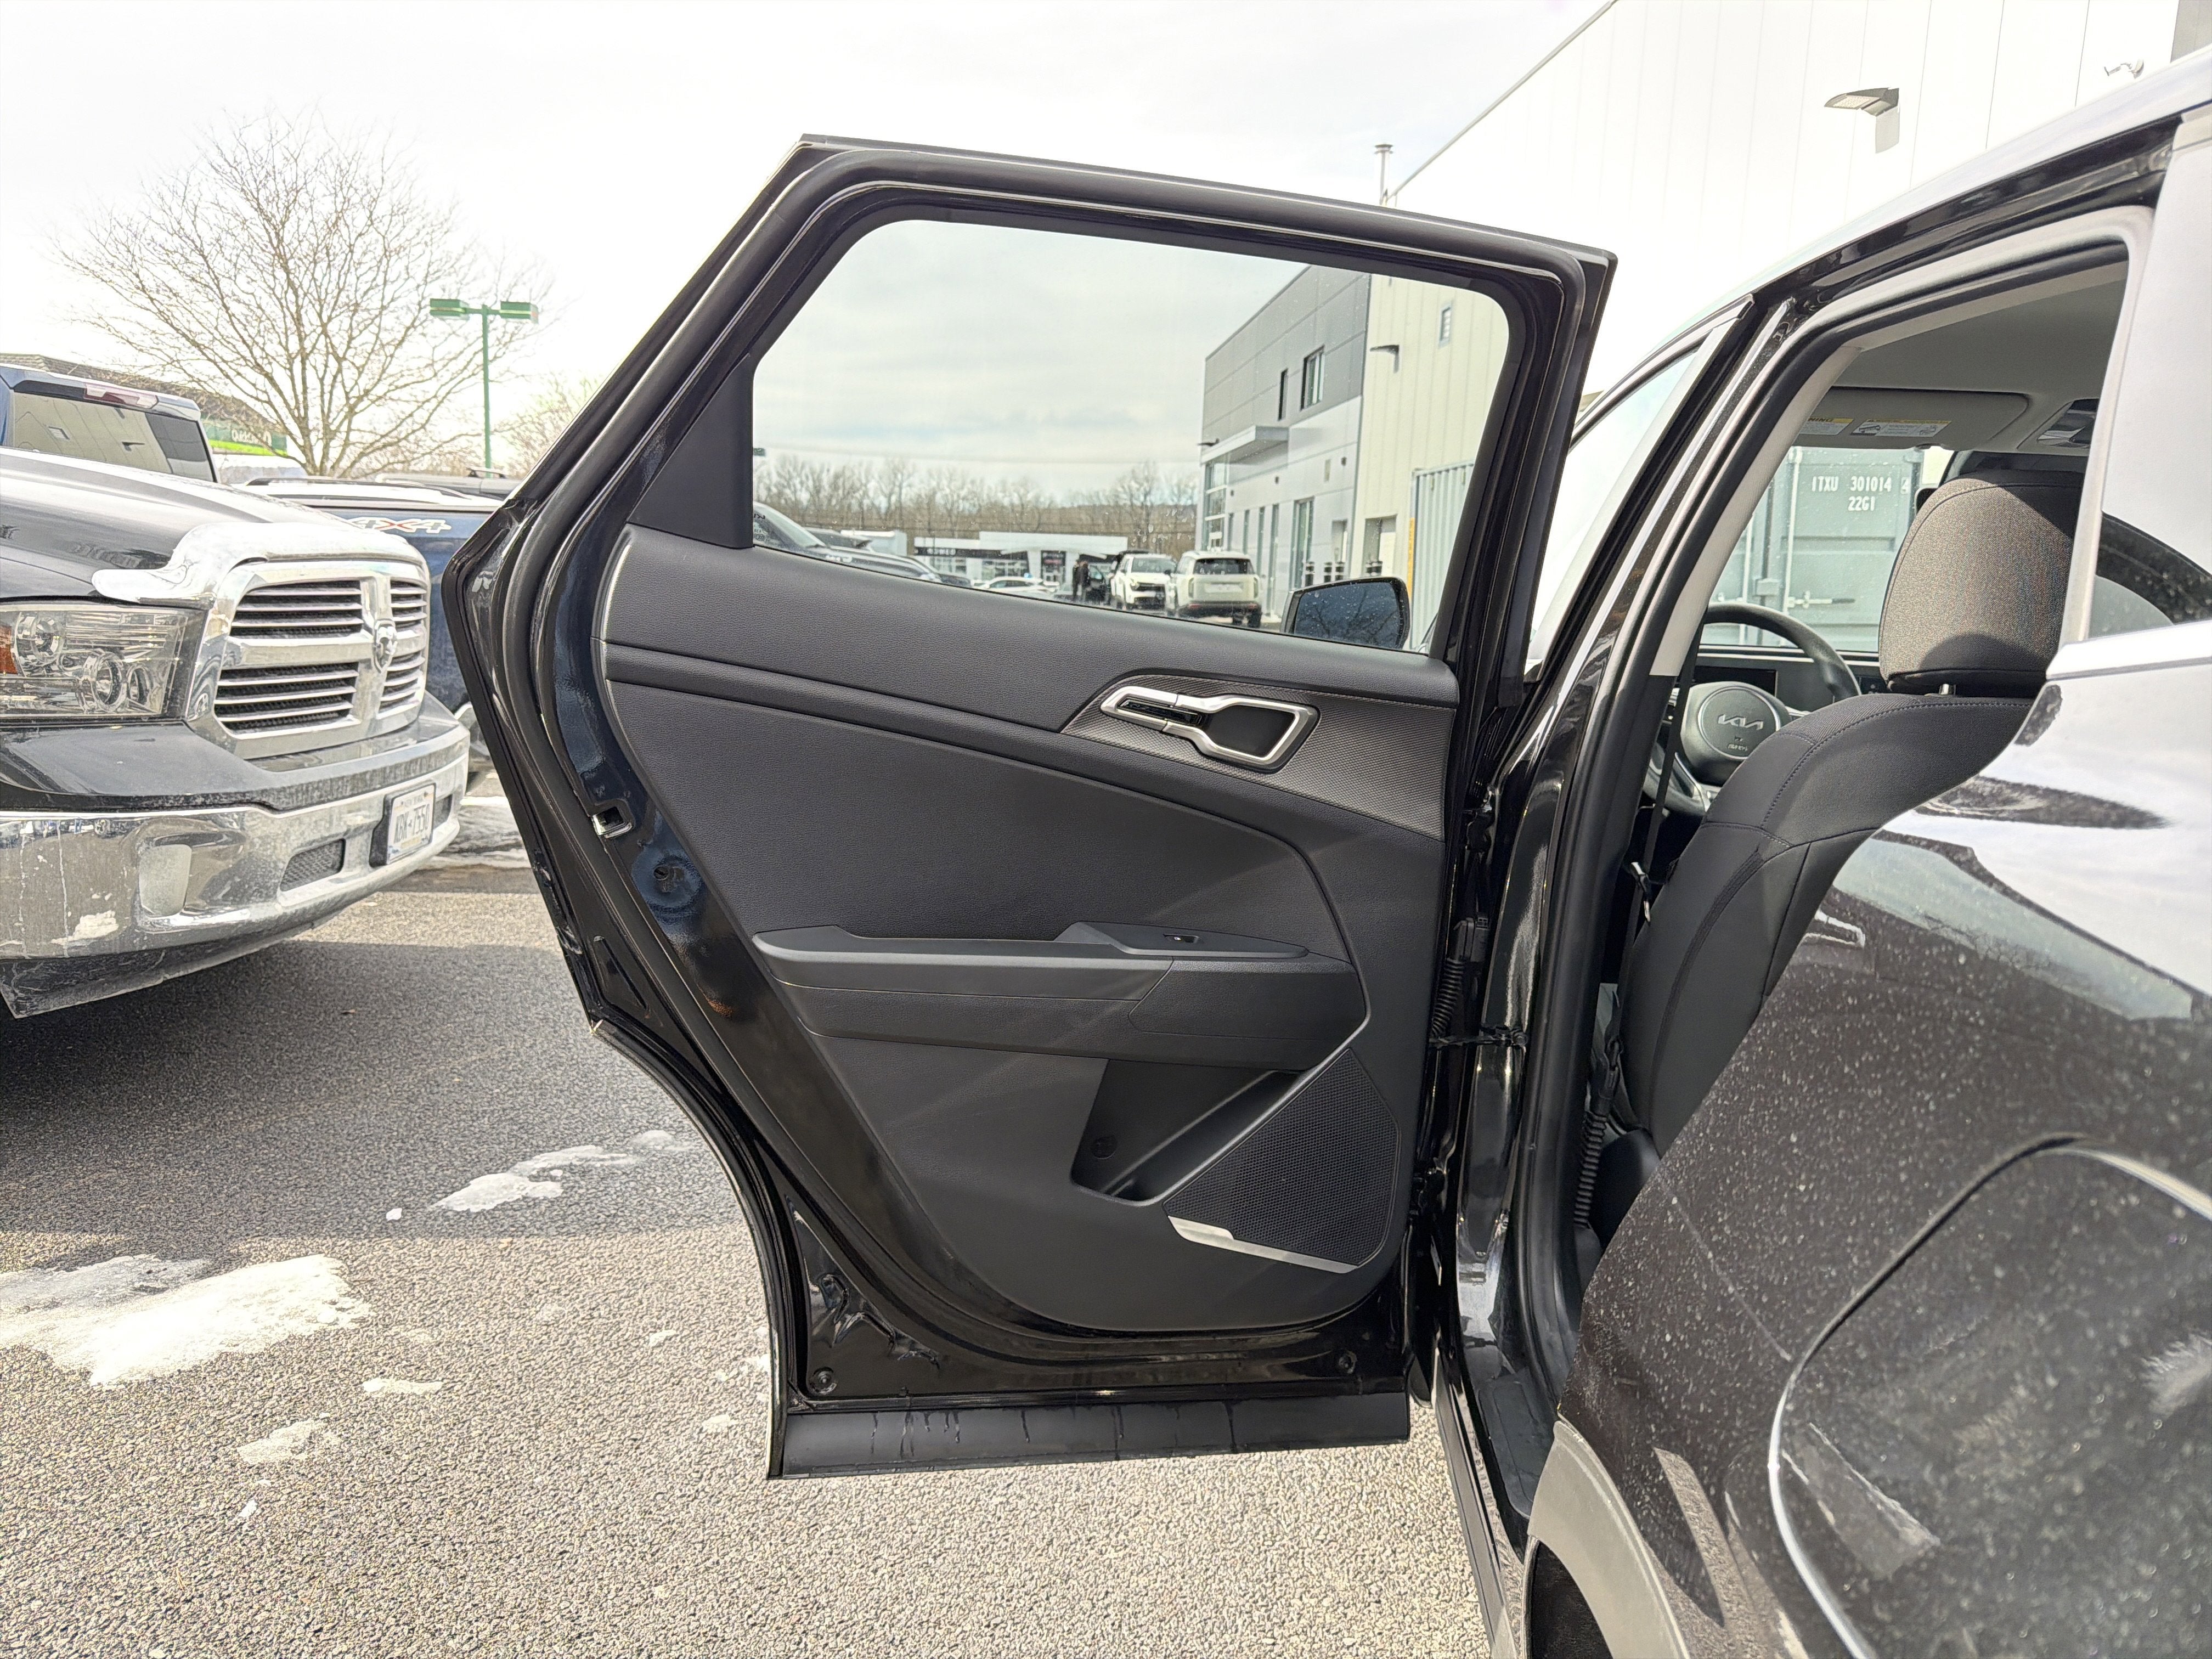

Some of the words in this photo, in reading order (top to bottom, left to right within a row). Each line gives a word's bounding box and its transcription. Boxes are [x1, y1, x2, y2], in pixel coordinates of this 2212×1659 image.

[1850, 476, 1892, 492] 301014
[1848, 496, 1876, 511] 22G1
[1718, 714, 1764, 730] KIA
